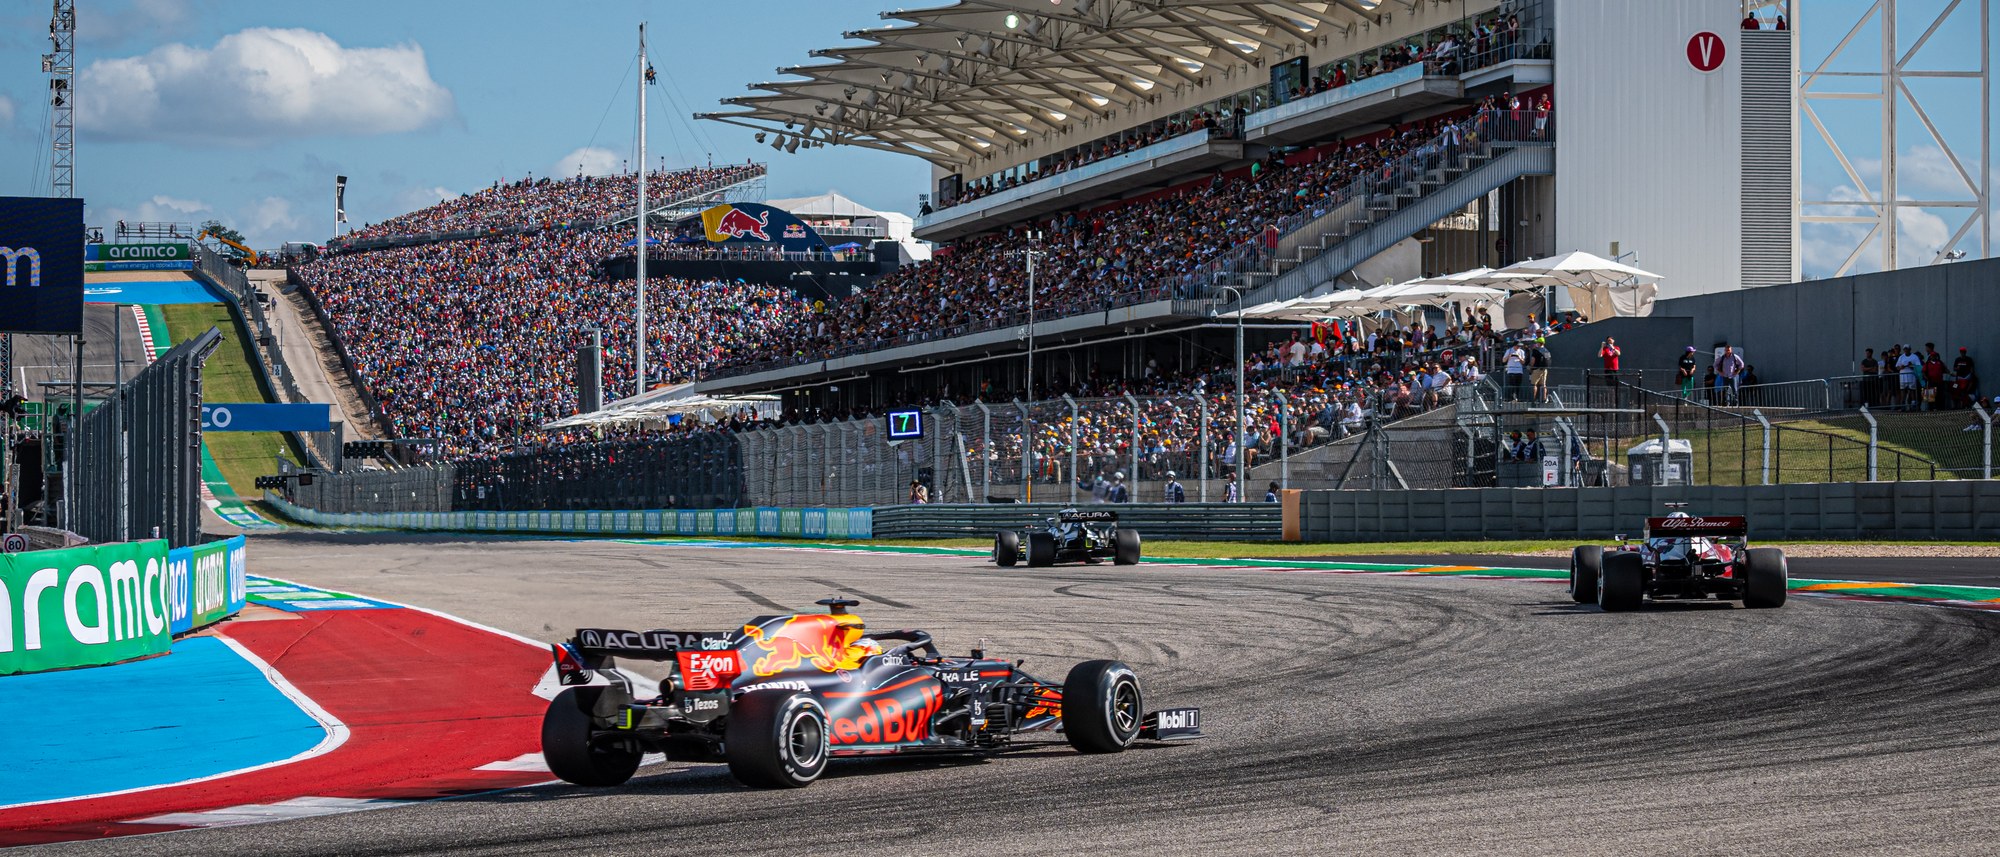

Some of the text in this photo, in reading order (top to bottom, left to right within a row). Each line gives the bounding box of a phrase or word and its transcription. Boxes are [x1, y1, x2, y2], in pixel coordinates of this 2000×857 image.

[1698, 36, 1714, 67] V
[109, 246, 177, 258] aramco
[898, 413, 910, 433] 7
[1547, 472, 1554, 482] F
[1071, 511, 1111, 519] ACURA
[1661, 515, 1731, 530] Alfa Romeo
[8, 540, 22, 551] 80
[195, 551, 224, 615] aramco
[701, 637, 730, 651] Claro
[690, 653, 733, 679] Exxon
[936, 669, 980, 683] RALE
[740, 680, 812, 693] HONDA
[694, 697, 720, 711] Tezos
[1158, 710, 1187, 730] Mobil
